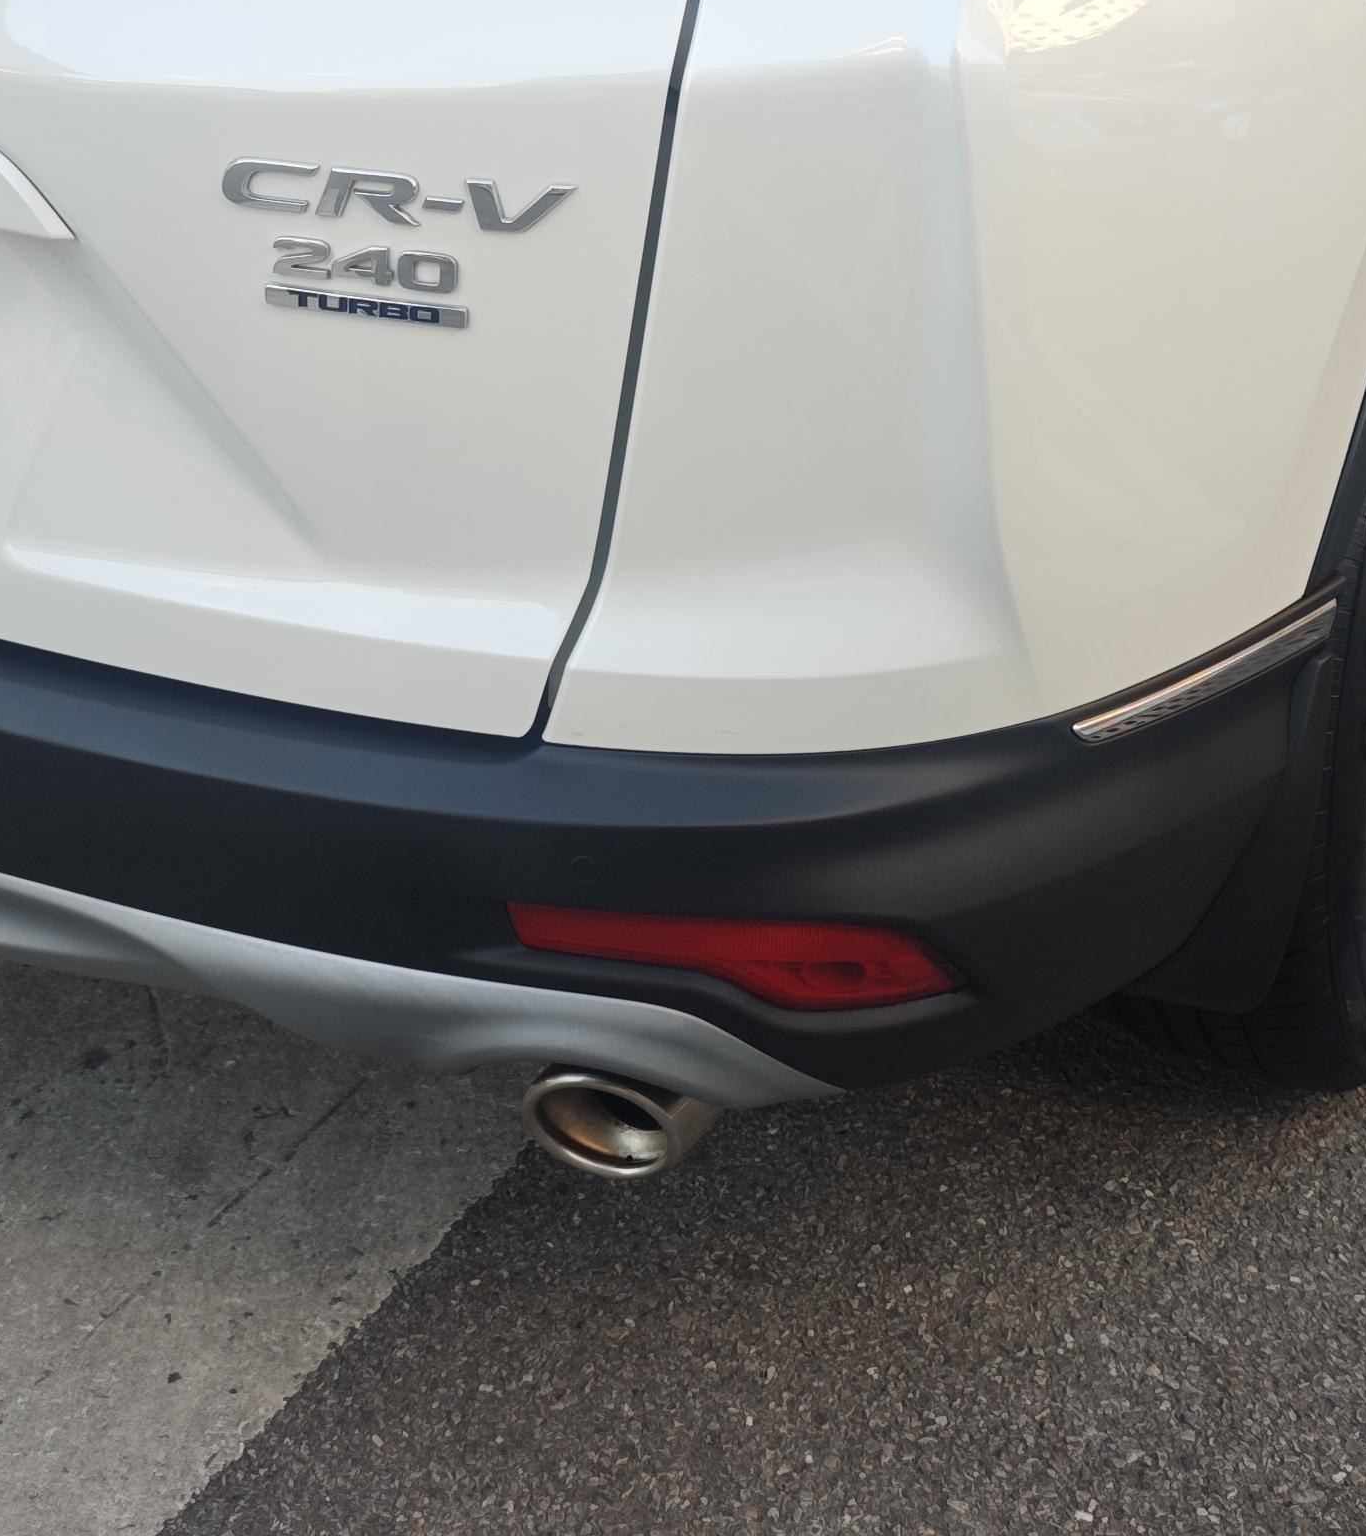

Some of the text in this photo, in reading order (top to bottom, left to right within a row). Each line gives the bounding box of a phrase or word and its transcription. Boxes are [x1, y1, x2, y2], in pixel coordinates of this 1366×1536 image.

[222, 156, 578, 233] CR-V
[272, 235, 459, 295] 240
[291, 289, 440, 325] TURBO
